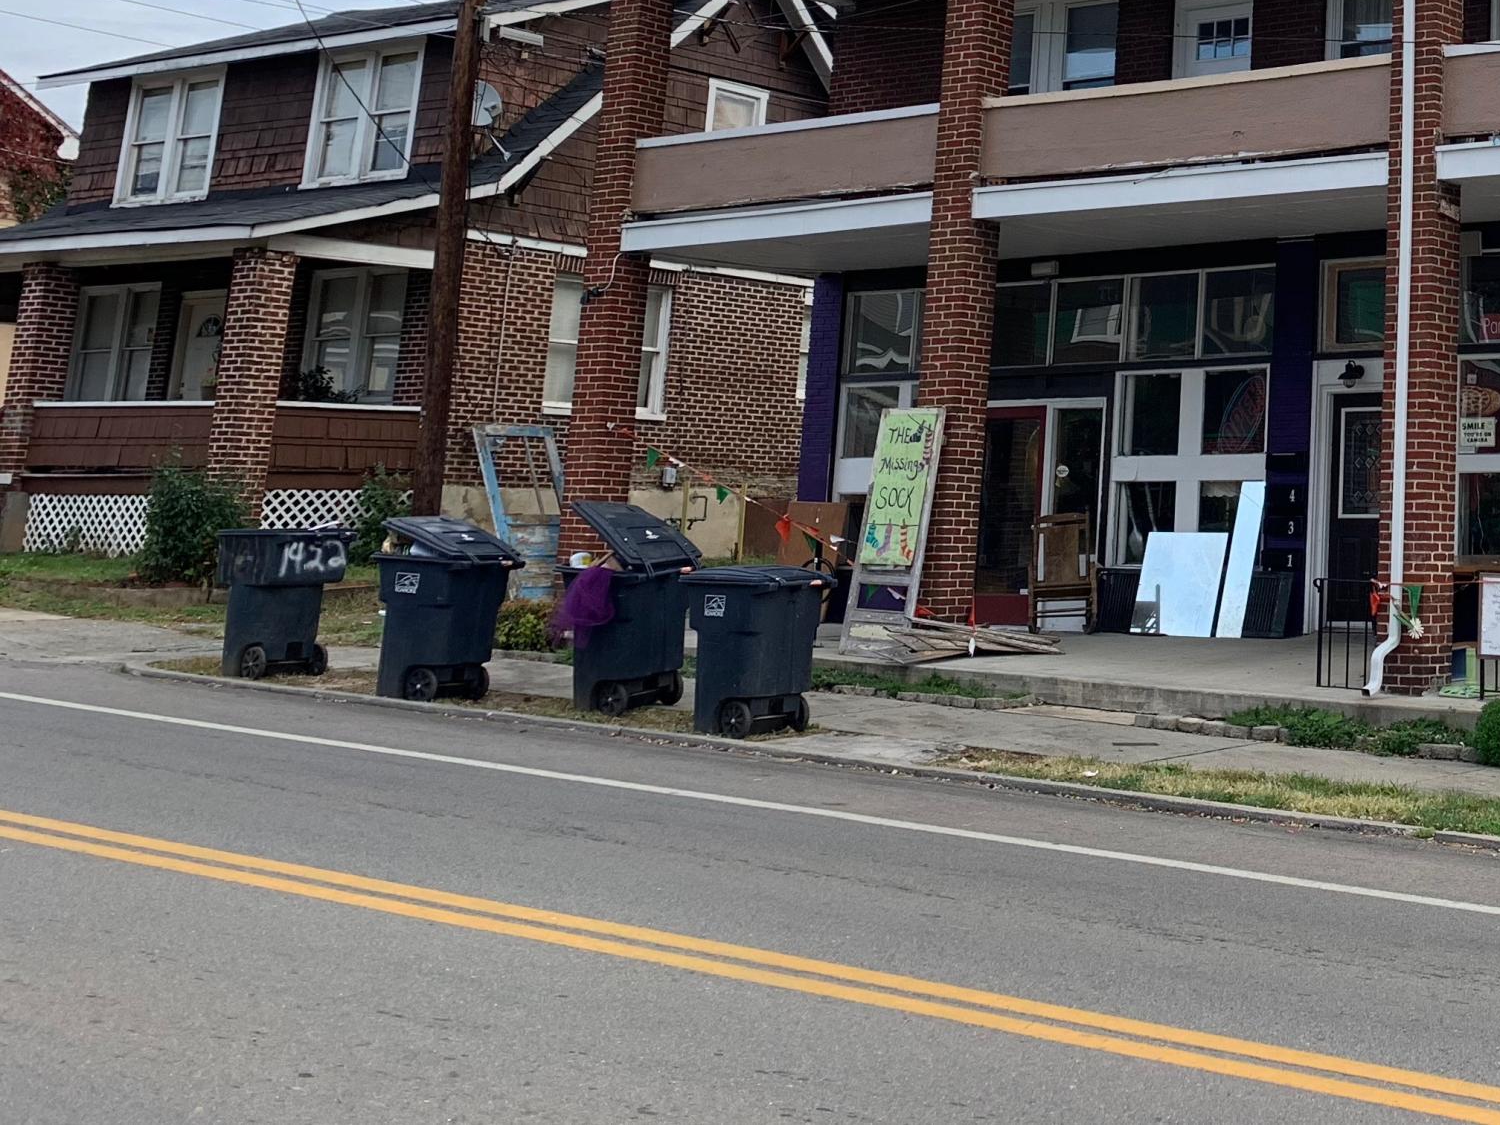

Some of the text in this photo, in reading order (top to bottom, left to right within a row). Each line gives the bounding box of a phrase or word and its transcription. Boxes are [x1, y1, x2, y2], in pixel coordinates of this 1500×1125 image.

[1462, 421, 1486, 431] SMILE
[889, 427, 912, 444] THE
[879, 457, 919, 481] Missing
[875, 485, 915, 518] SOCK
[1288, 488, 1297, 504] 4
[1287, 520, 1295, 535] 3
[278, 539, 348, 578] 1422
[1286, 554, 1293, 568] 1
